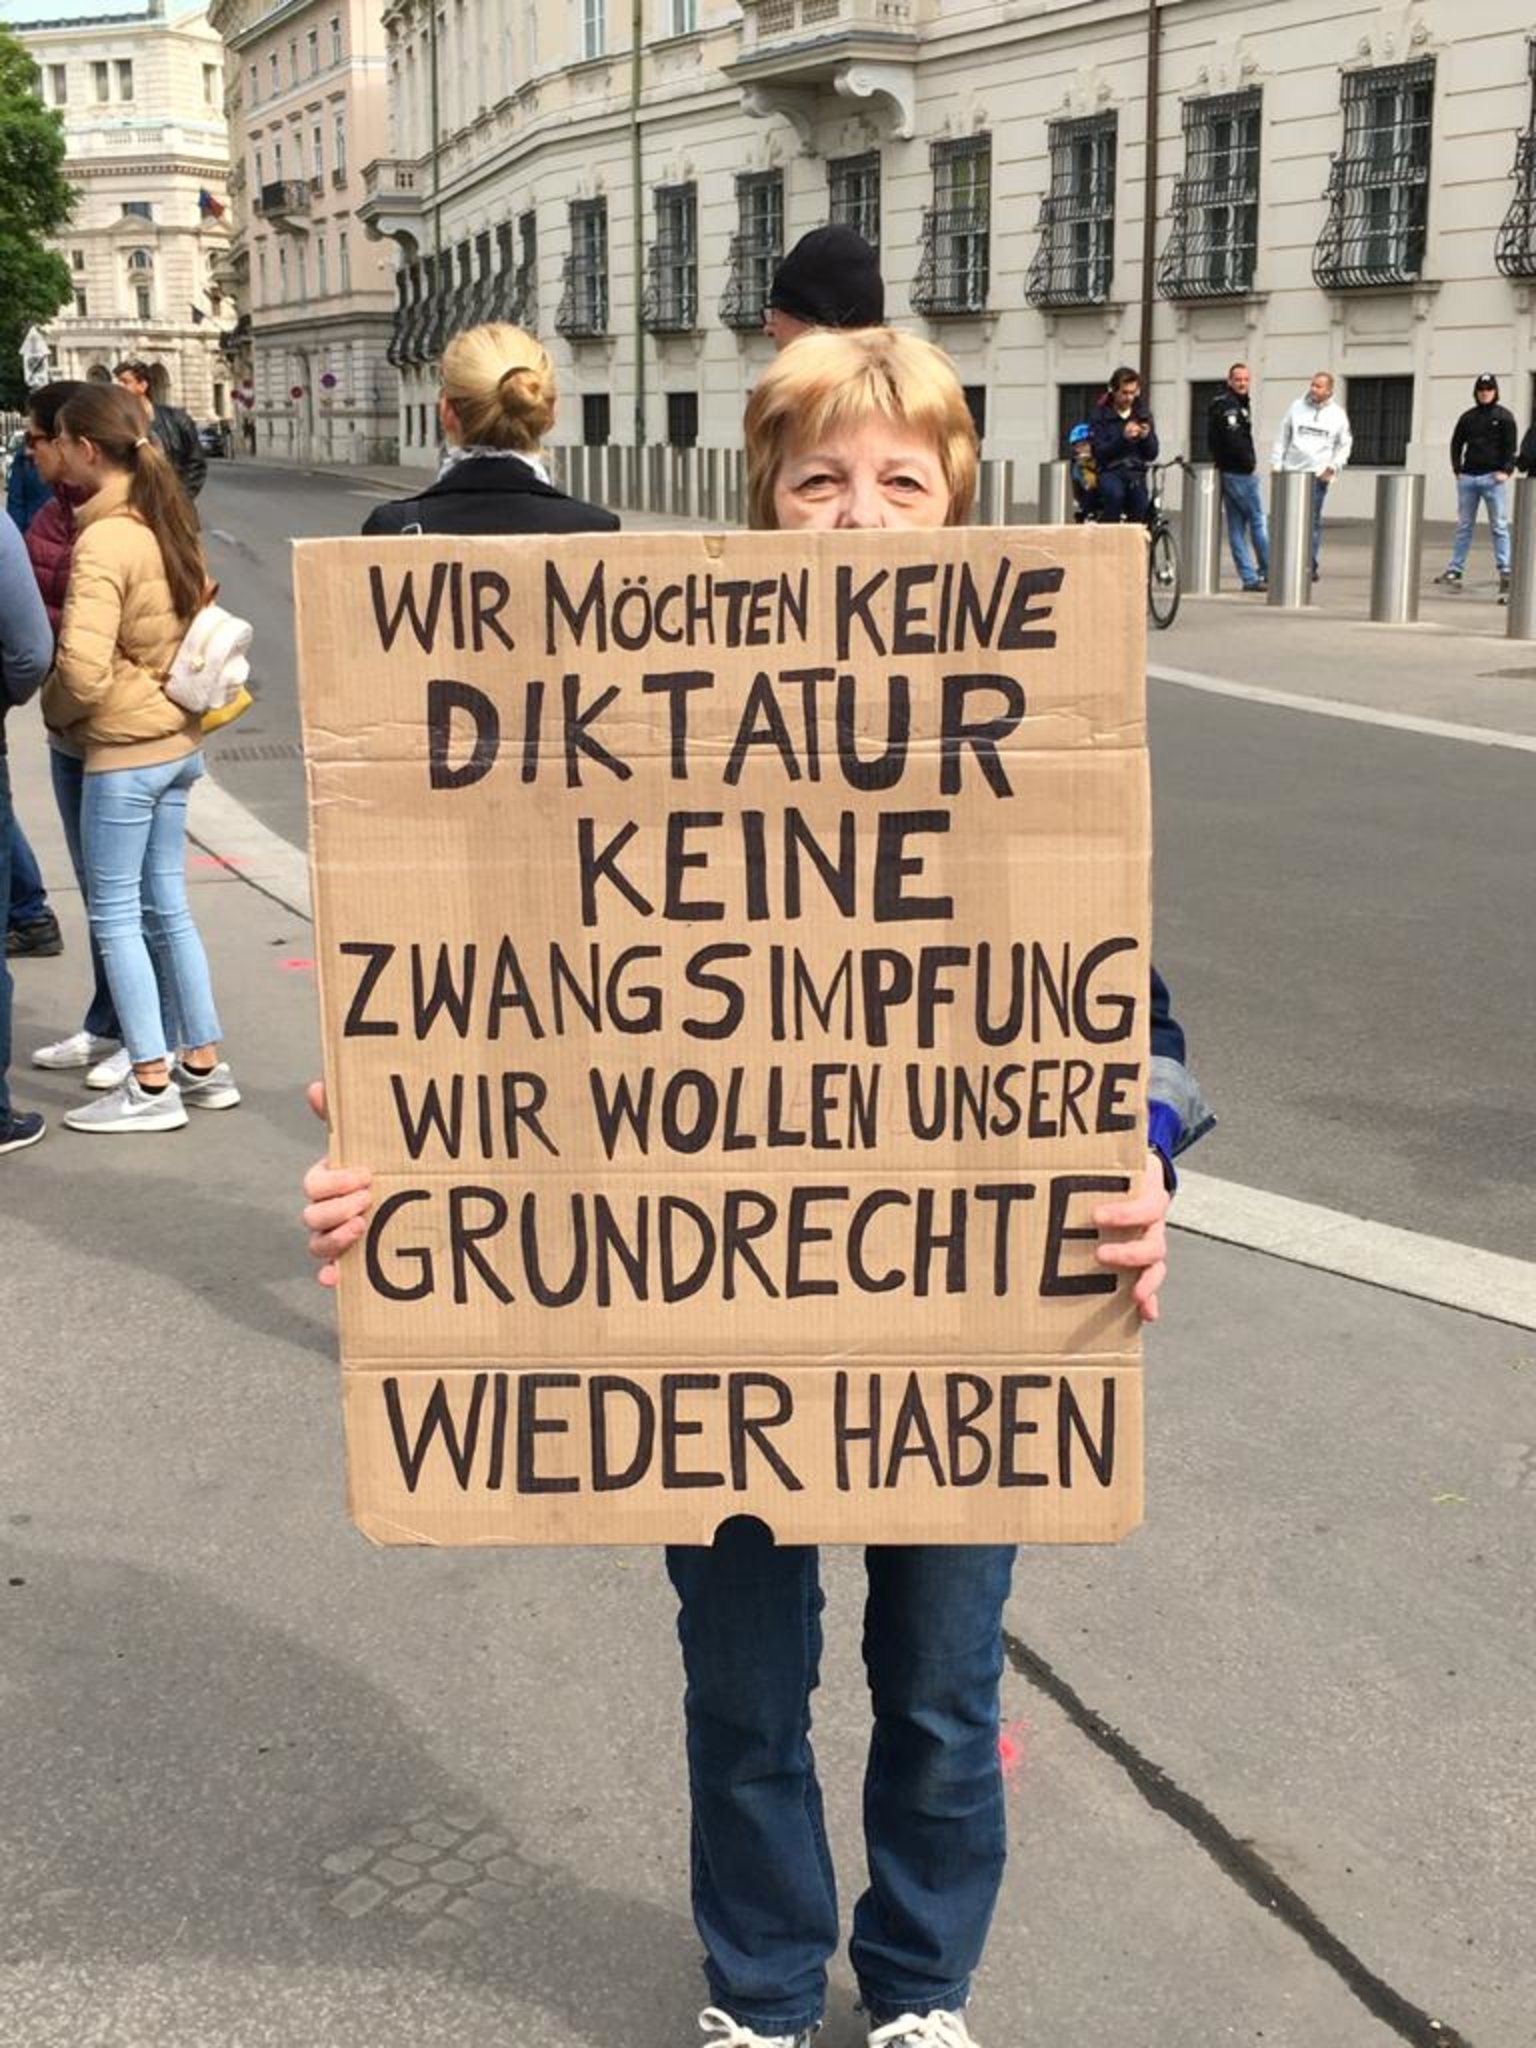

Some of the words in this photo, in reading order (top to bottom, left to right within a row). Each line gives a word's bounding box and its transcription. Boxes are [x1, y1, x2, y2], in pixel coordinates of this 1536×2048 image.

[370, 563, 514, 653] WIR
[546, 561, 808, 655] MÖCHTEN
[837, 558, 1064, 660] KEINE
[428, 668, 1025, 798] DIKTATUR
[578, 808, 953, 926] KEINE
[340, 936, 1138, 1046] ZWANGSIMPFUNG
[391, 1072, 559, 1159] WIR
[590, 1064, 880, 1160] WOLLEN
[907, 1060, 1139, 1140] UNSERE
[366, 1176, 1132, 1306] GRUNDRECHTE
[383, 1373, 803, 1493] WIEDER
[835, 1372, 1114, 1490] HABEN
